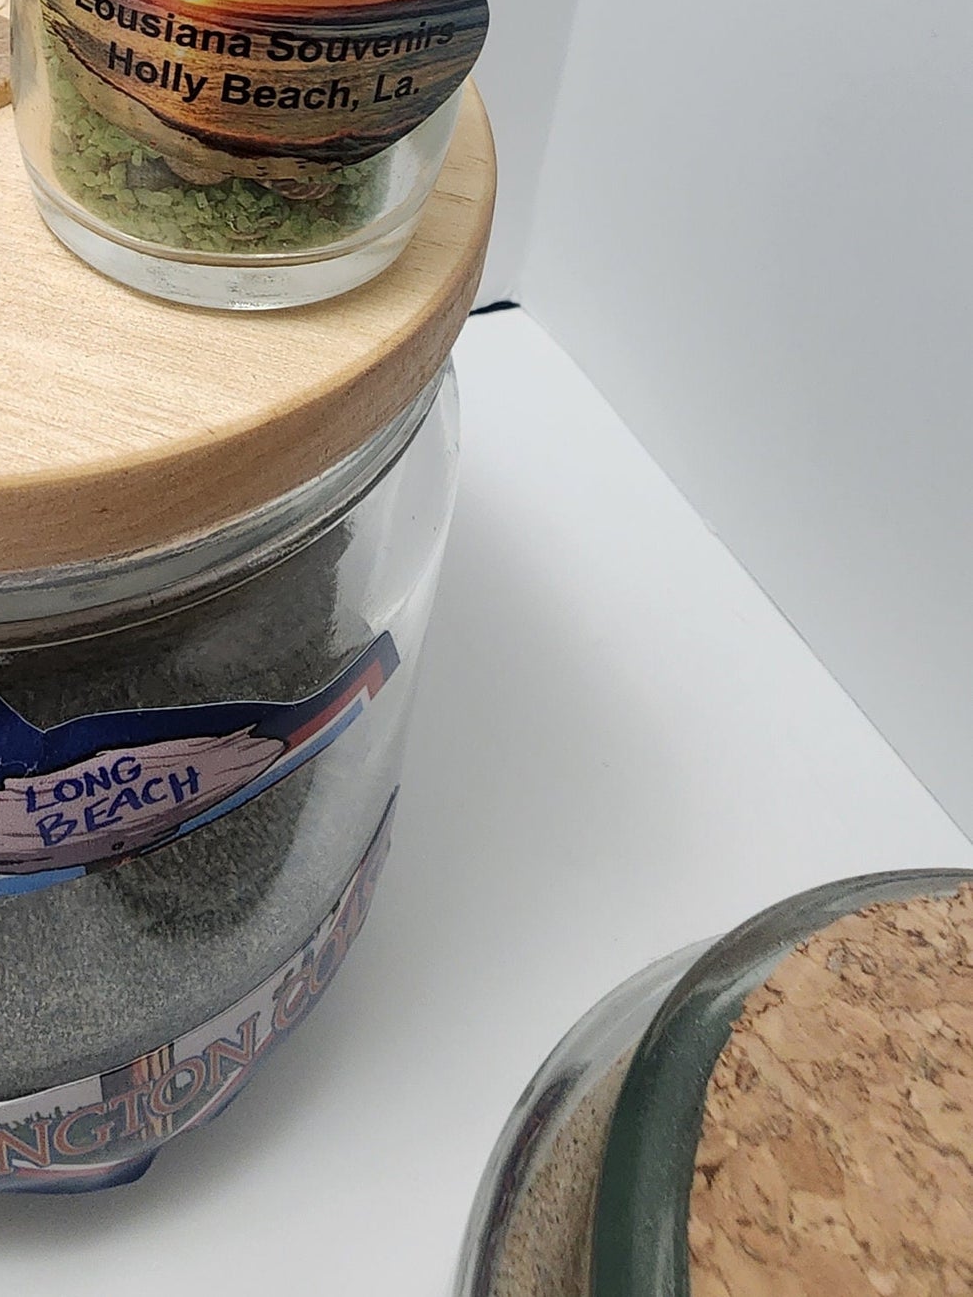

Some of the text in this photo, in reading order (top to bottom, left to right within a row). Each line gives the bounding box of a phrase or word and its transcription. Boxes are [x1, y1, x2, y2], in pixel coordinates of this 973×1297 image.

[267, 18, 456, 63] Souvenirs
[107, 40, 421, 113] Holly Beach, La.
[25, 754, 143, 816] LONG
[37, 764, 201, 848] BEACH
